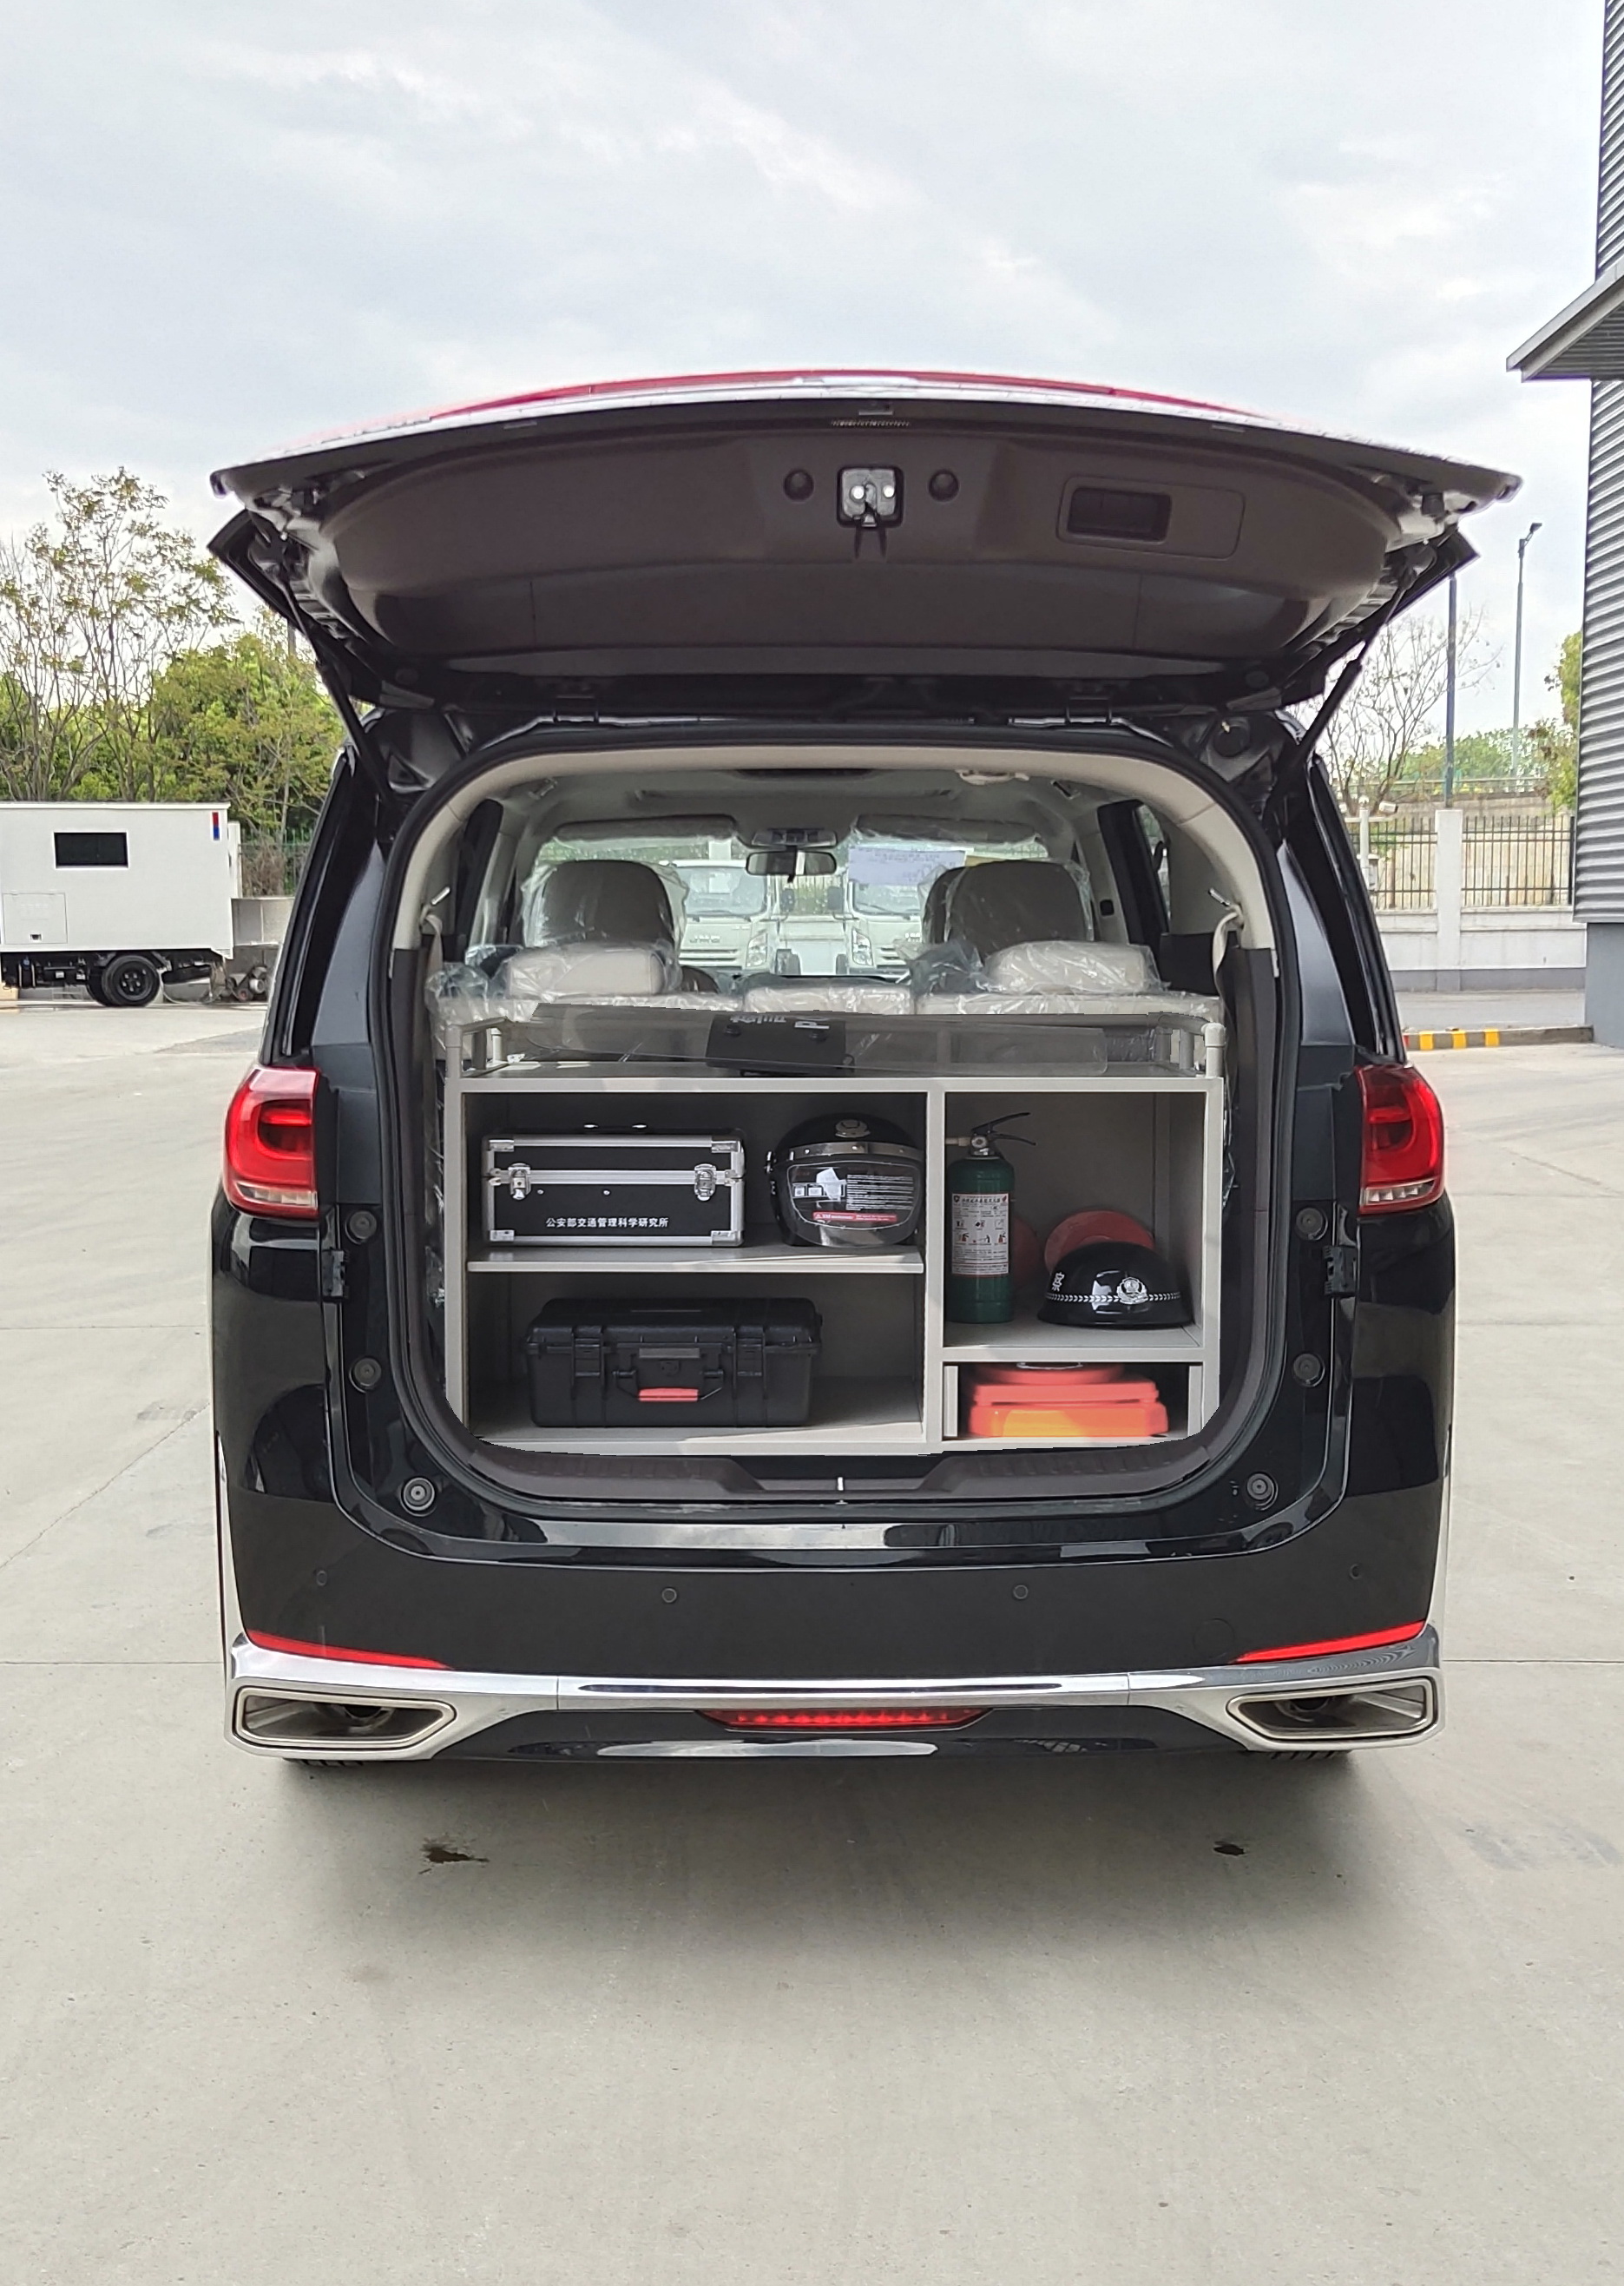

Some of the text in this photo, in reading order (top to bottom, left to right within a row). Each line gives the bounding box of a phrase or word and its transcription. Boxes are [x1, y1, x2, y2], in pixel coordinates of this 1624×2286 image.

[545, 1217, 669, 1229] 公安部交通管理科学研究所
[1051, 1271, 1066, 1292] 察
